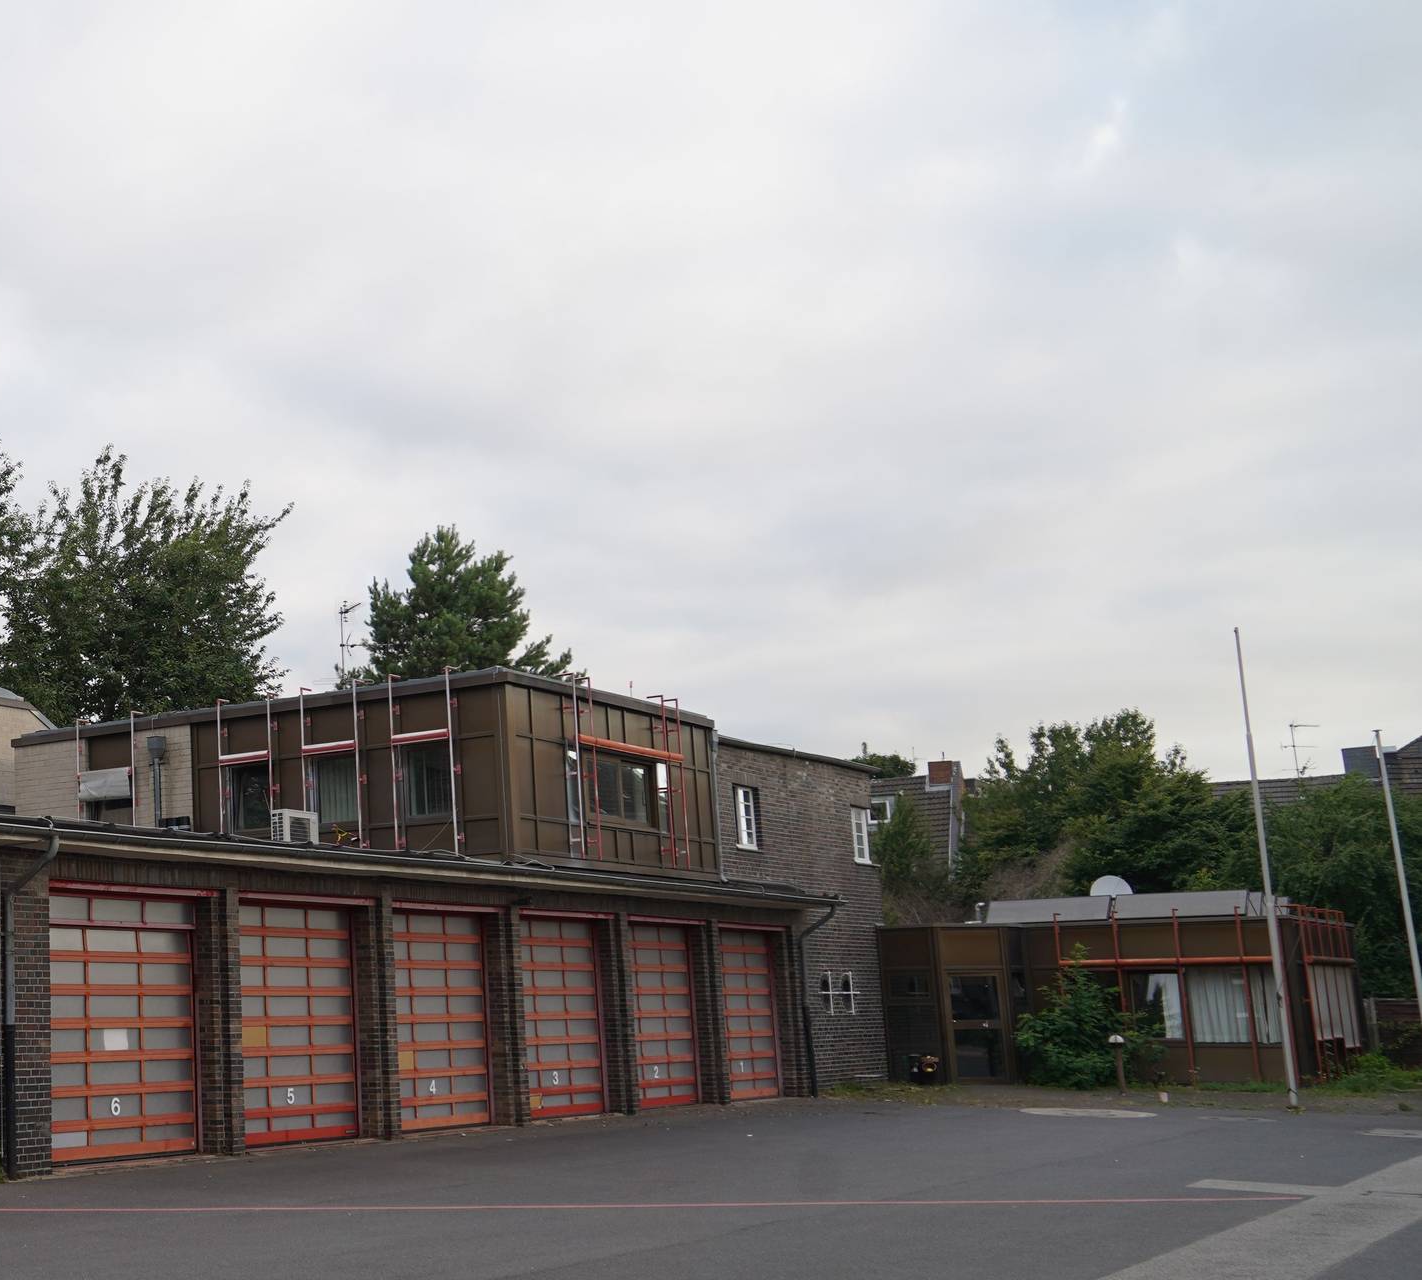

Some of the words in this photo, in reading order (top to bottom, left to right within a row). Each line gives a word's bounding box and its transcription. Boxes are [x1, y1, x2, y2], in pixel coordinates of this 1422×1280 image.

[653, 1065, 659, 1079] 2
[740, 1060, 744, 1073] 1
[553, 1071, 559, 1085] 3
[429, 1079, 436, 1095] 4
[287, 1087, 295, 1105] 5
[111, 1097, 121, 1116] 6
